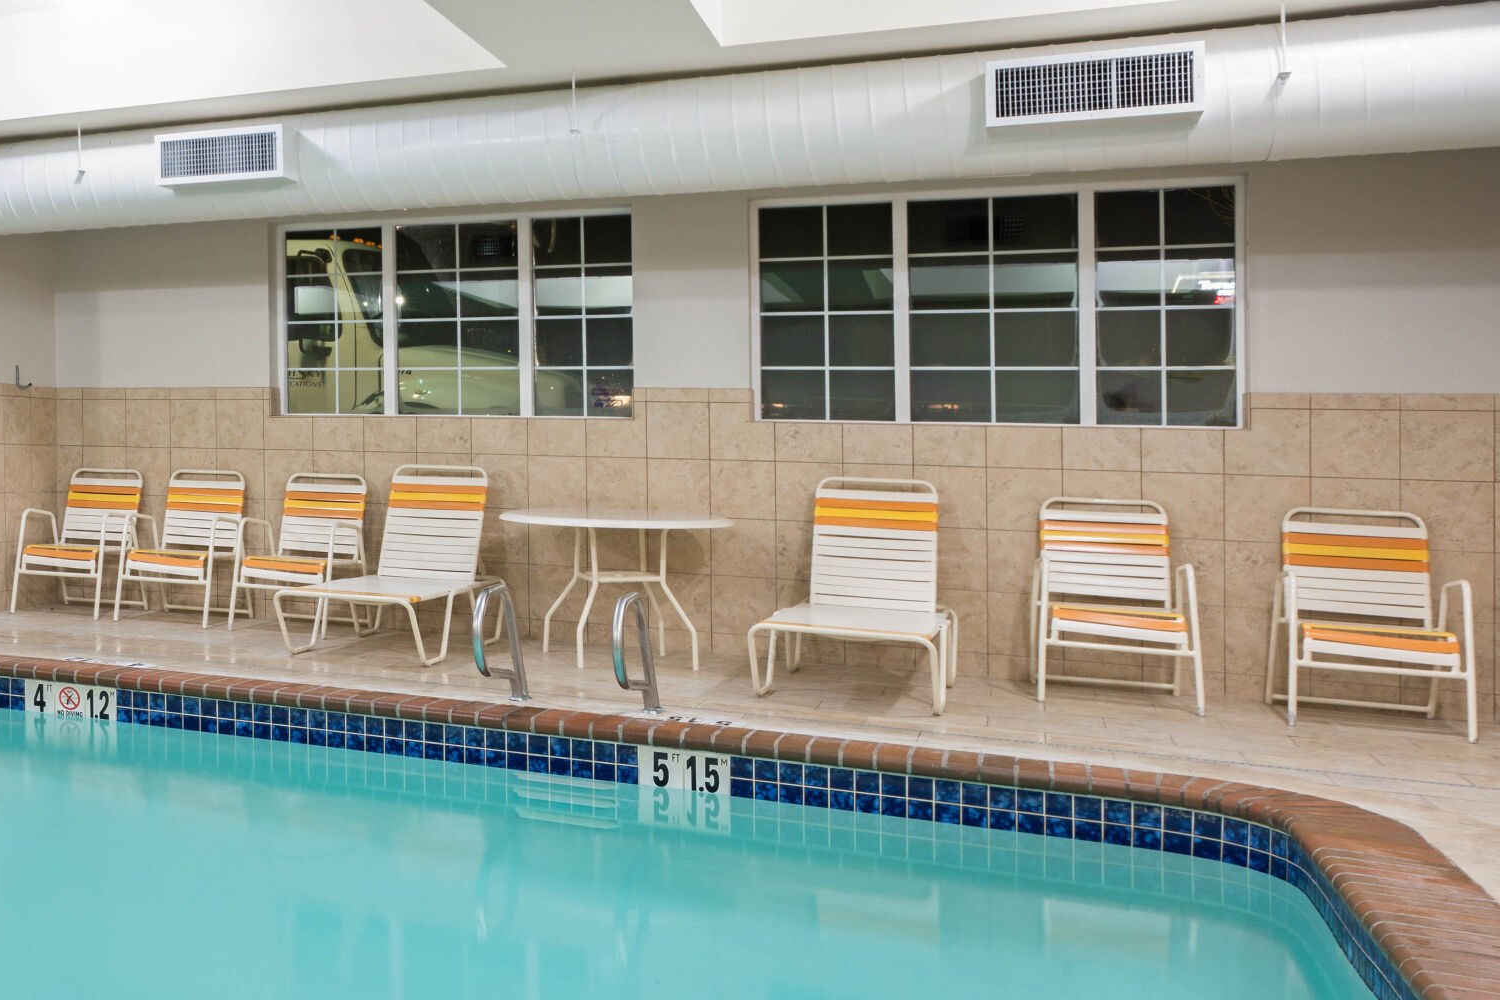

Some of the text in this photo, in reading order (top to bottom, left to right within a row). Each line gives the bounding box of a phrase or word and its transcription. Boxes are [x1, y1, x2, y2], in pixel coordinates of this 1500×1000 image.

[34, 684, 46, 712] 4
[47, 684, 52, 692] FT
[87, 689, 110, 720] 1.2
[653, 752, 669, 787] 5
[672, 754, 680, 762] FT
[686, 756, 720, 793] 1.5
